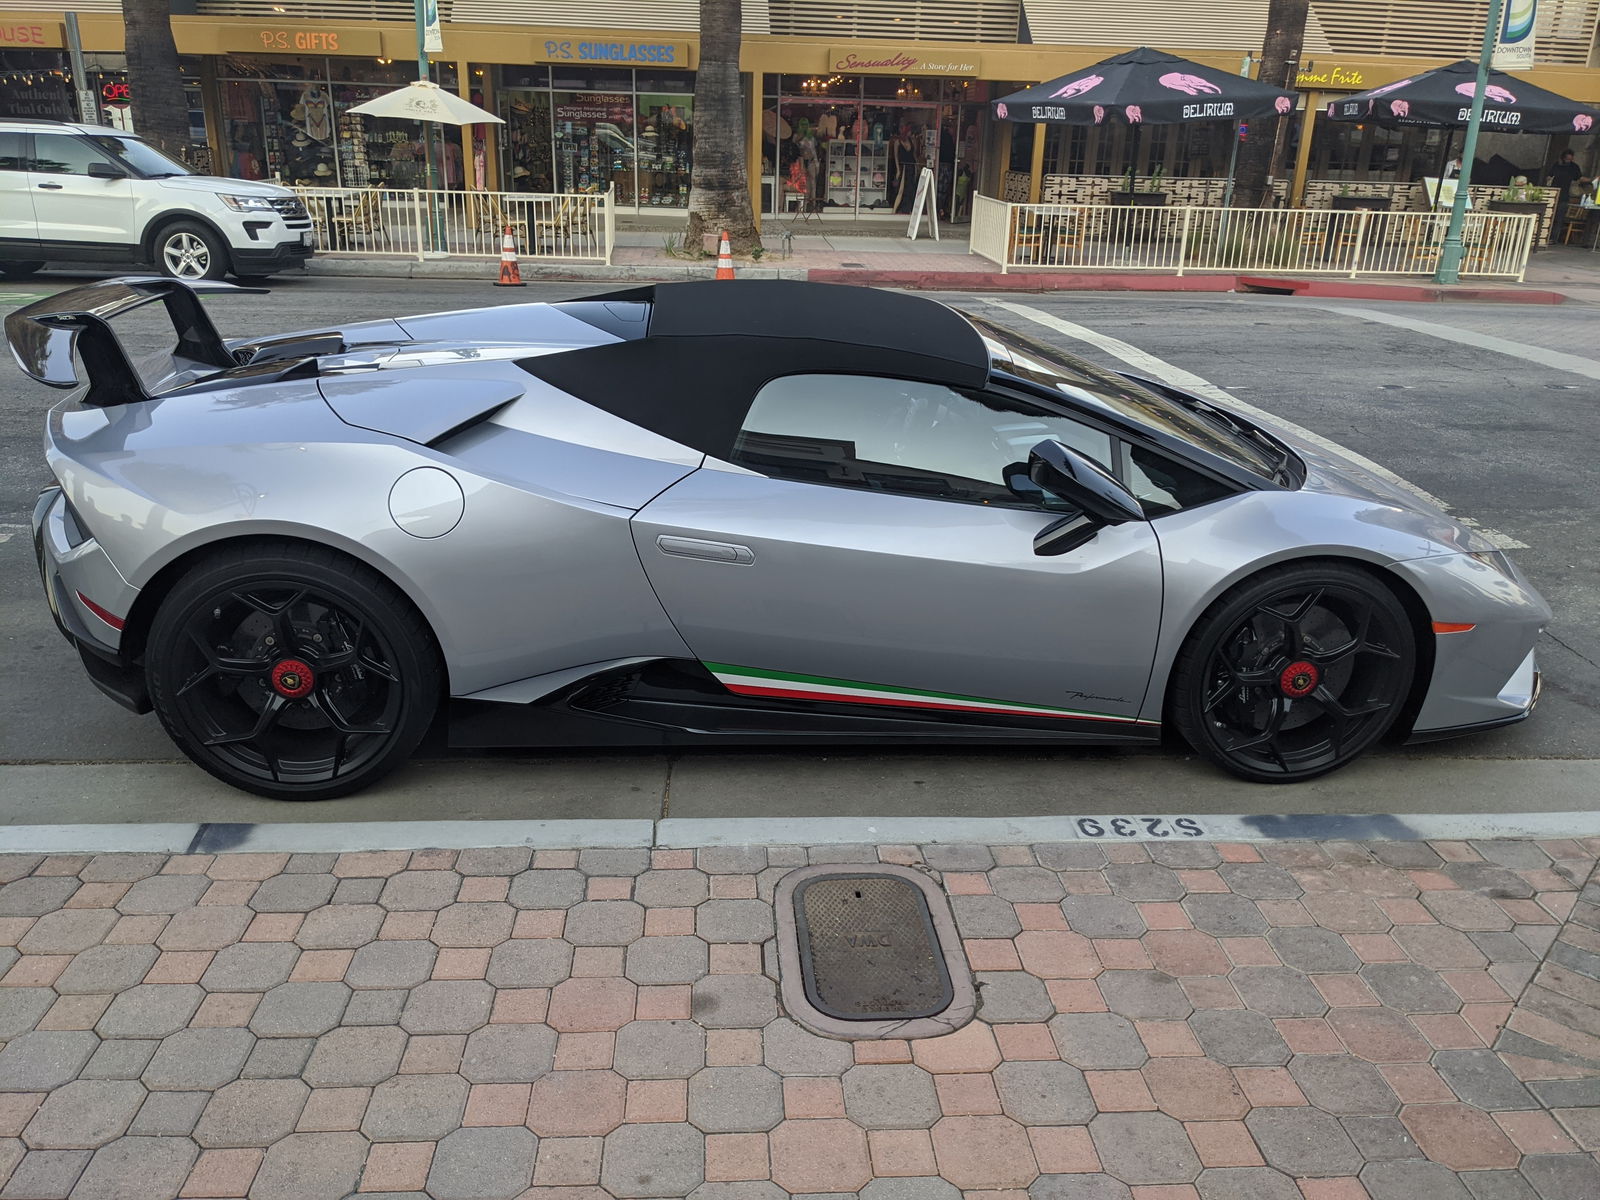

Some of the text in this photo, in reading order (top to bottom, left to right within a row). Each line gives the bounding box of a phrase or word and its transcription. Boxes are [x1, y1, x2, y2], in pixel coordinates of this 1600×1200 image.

[260, 31, 339, 50] P.S. GIFTS
[544, 40, 675, 62] P.S. SUNGLASSES
[1497, 46, 1532, 54] DOWNTOWN
[836, 52, 918, 72] Sensuality
[927, 62, 945, 71] Store
[945, 62, 958, 72] for
[959, 63, 974, 72] Her
[1330, 67, 1364, 85] Frite
[557, 107, 607, 119] Sunglasses
[1031, 106, 1066, 119] DELIRIUM
[1183, 102, 1234, 118] DELIRIUM
[1458, 108, 1521, 125] DEIRIUM
[1077, 818, 1204, 837] S239
